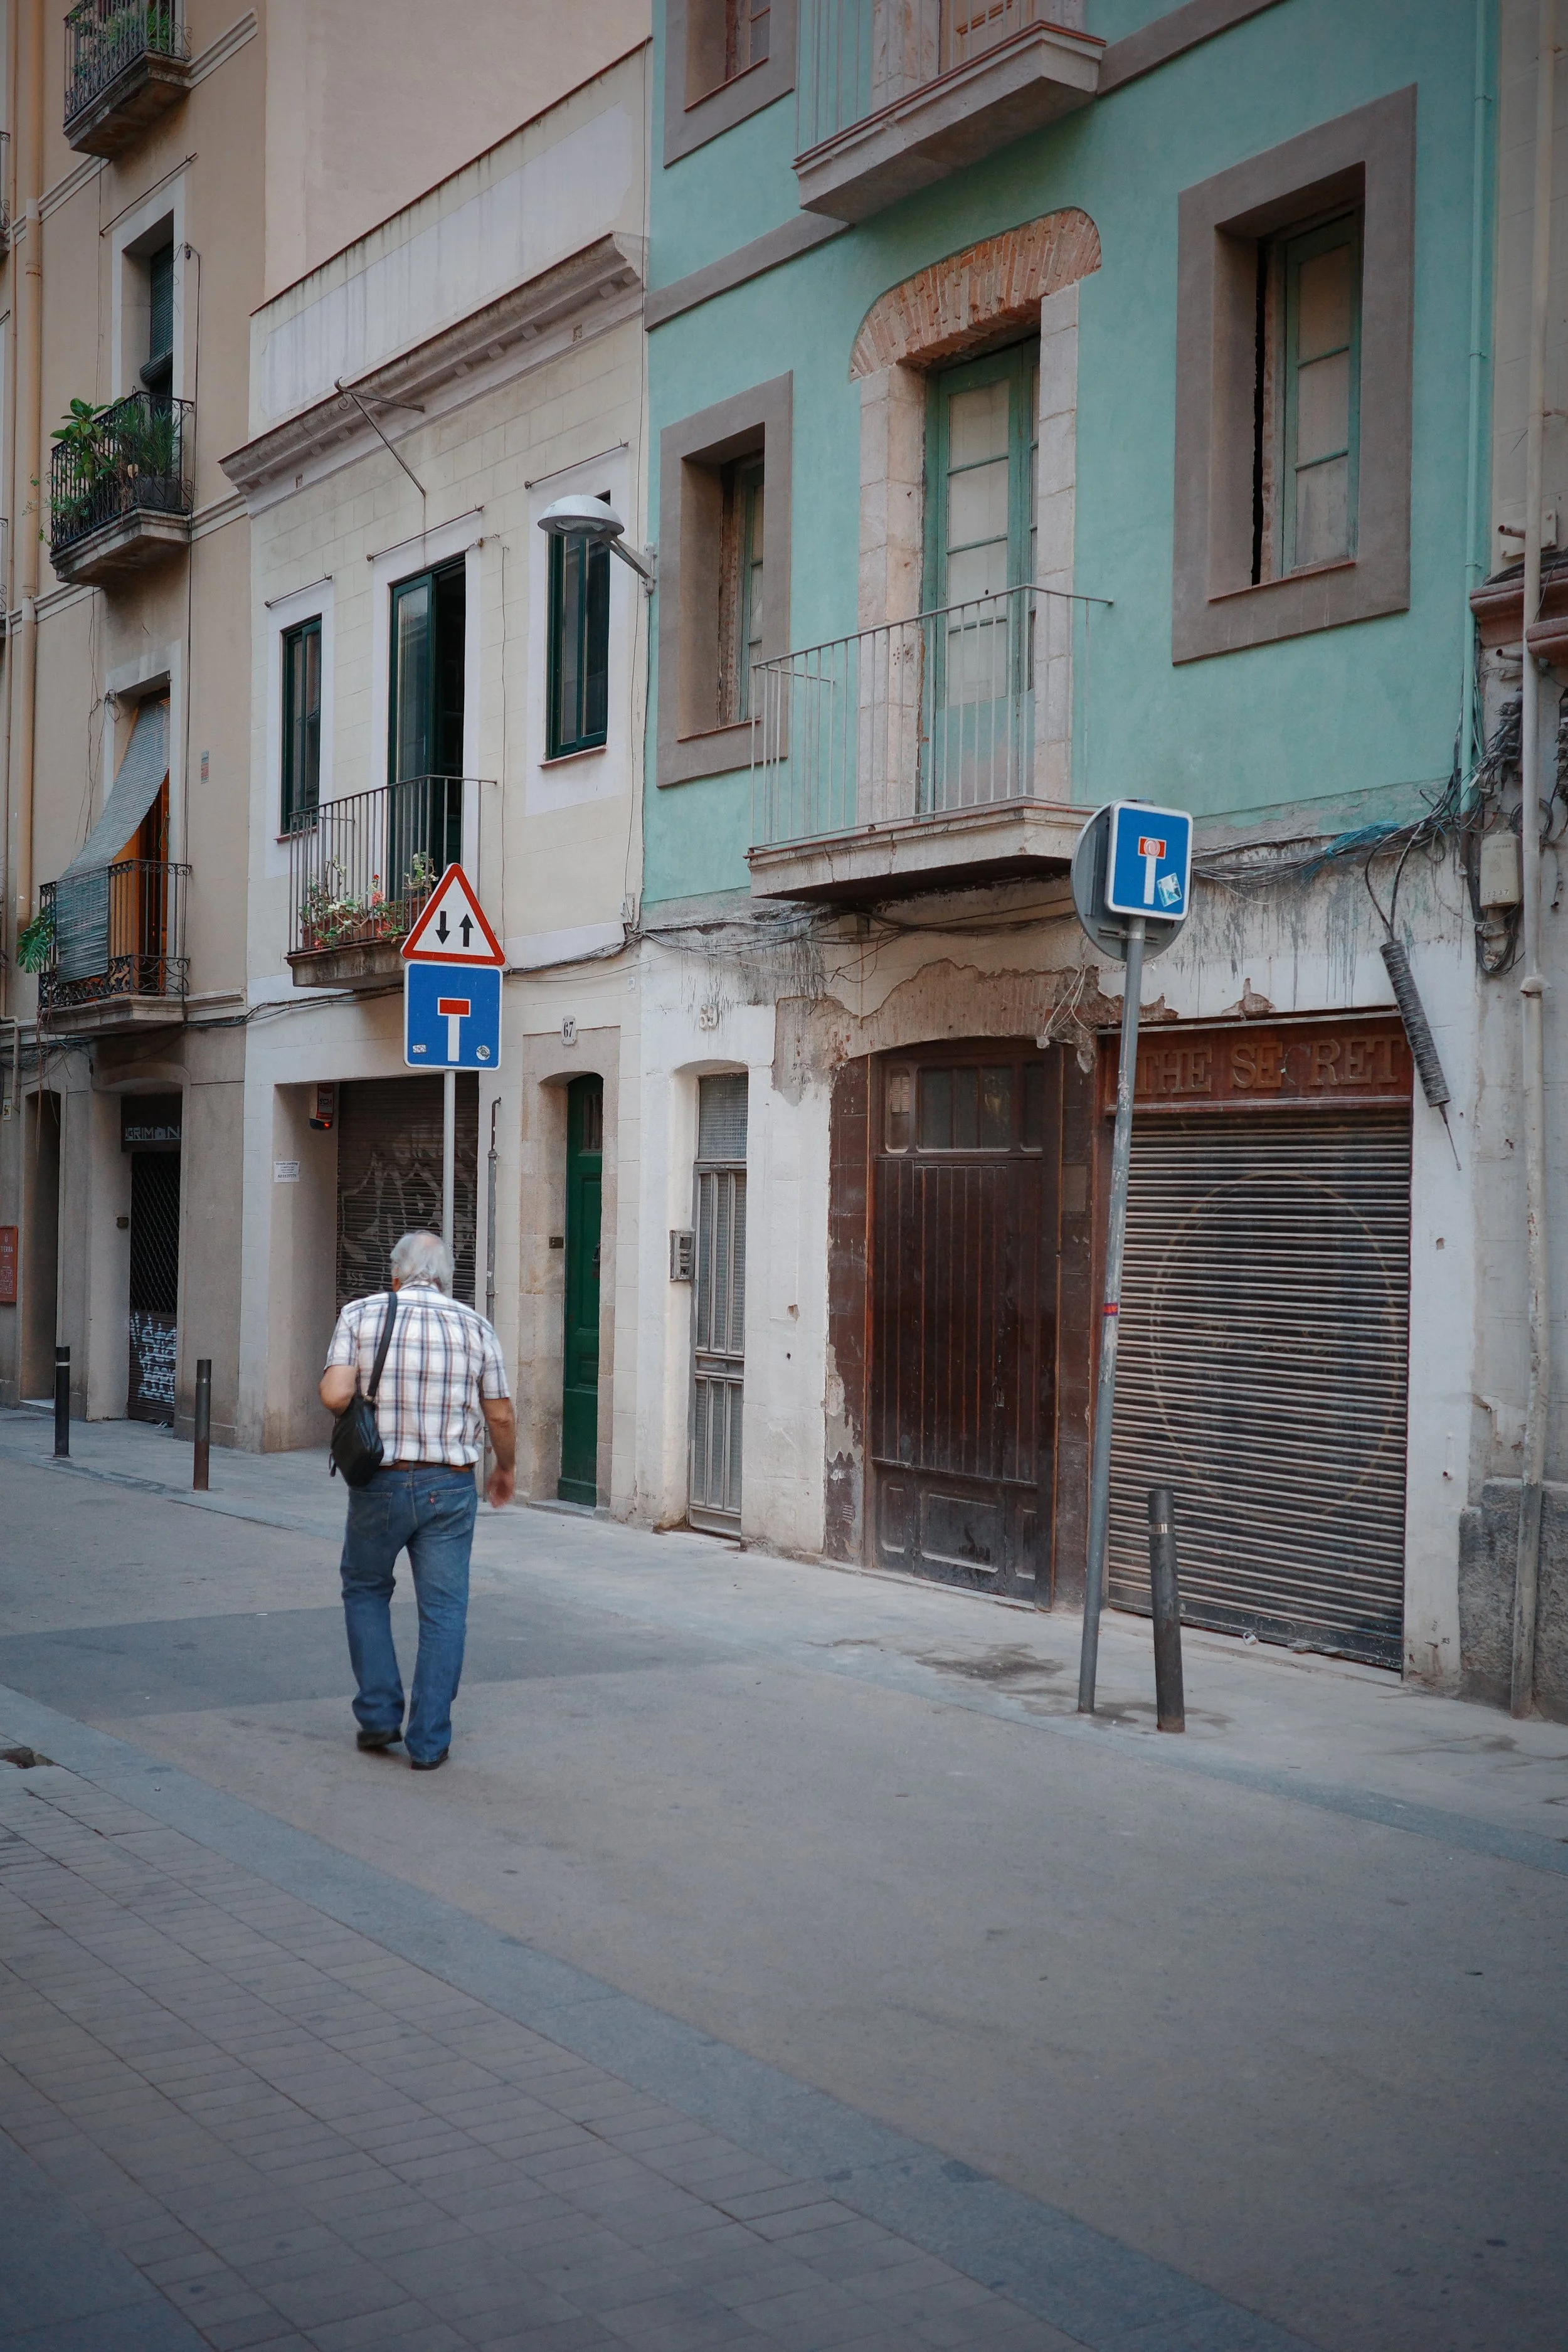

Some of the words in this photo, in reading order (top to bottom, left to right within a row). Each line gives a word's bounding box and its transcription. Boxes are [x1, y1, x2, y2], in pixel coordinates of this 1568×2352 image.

[699, 1003, 718, 1029] 69
[563, 1021, 574, 1038] 67
[1134, 1047, 1212, 1096] THE
